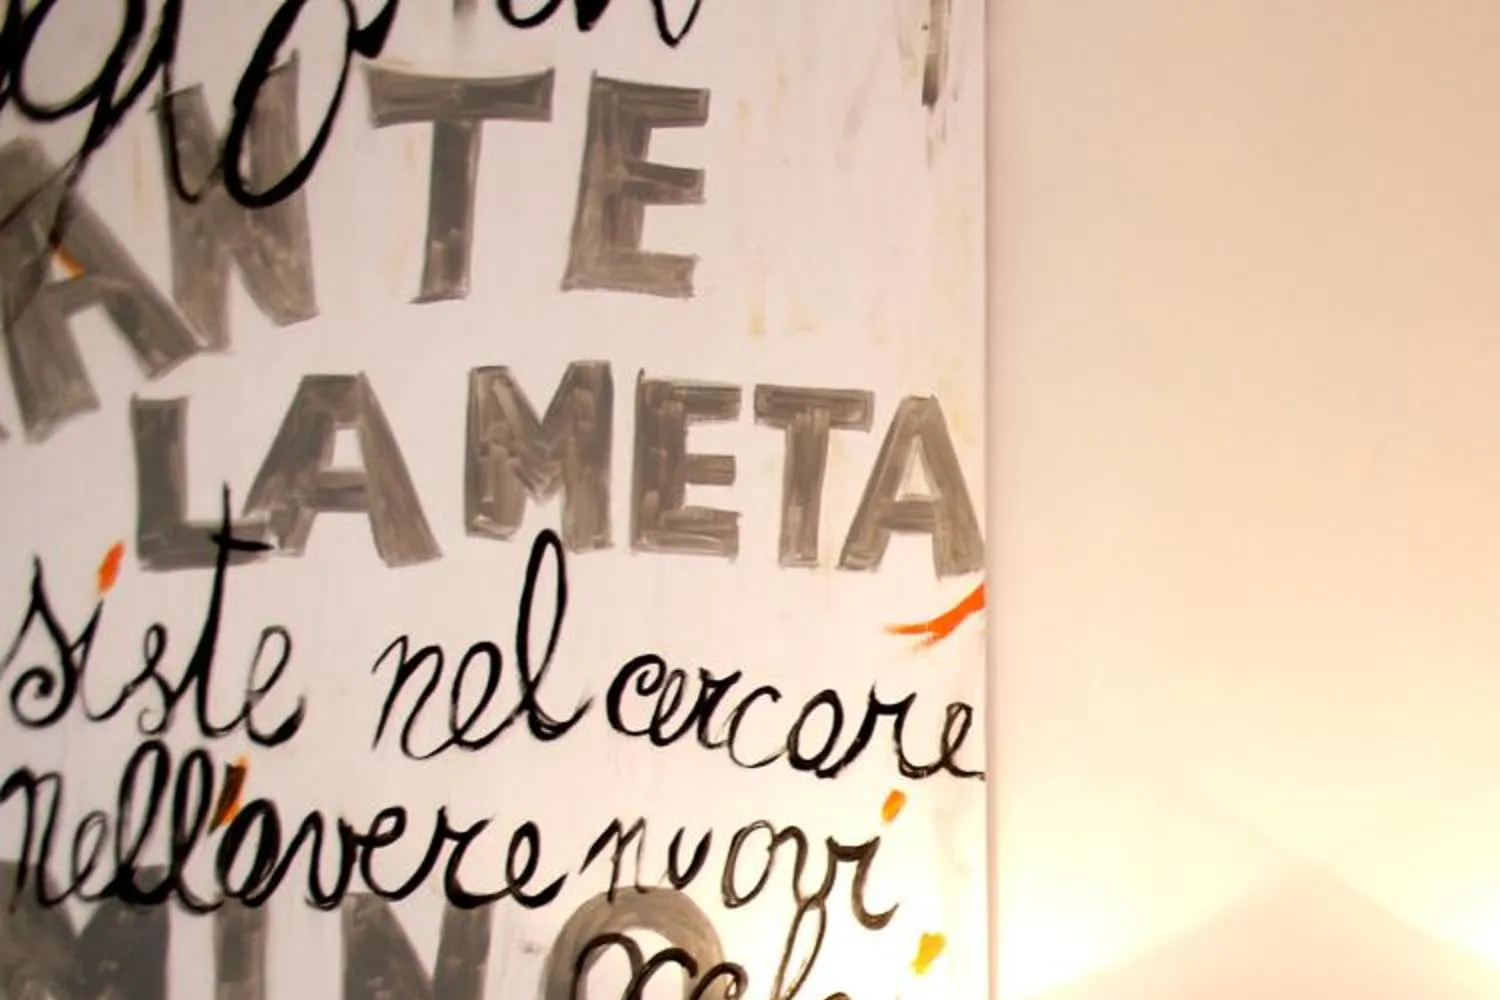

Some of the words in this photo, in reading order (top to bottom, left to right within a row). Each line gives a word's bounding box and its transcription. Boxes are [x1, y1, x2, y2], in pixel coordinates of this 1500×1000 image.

[0, 50, 712, 443] ANTE
[132, 370, 443, 570] LA
[464, 360, 985, 580] META
[372, 528, 592, 760] nel
[582, 790, 907, 930] nuovi
